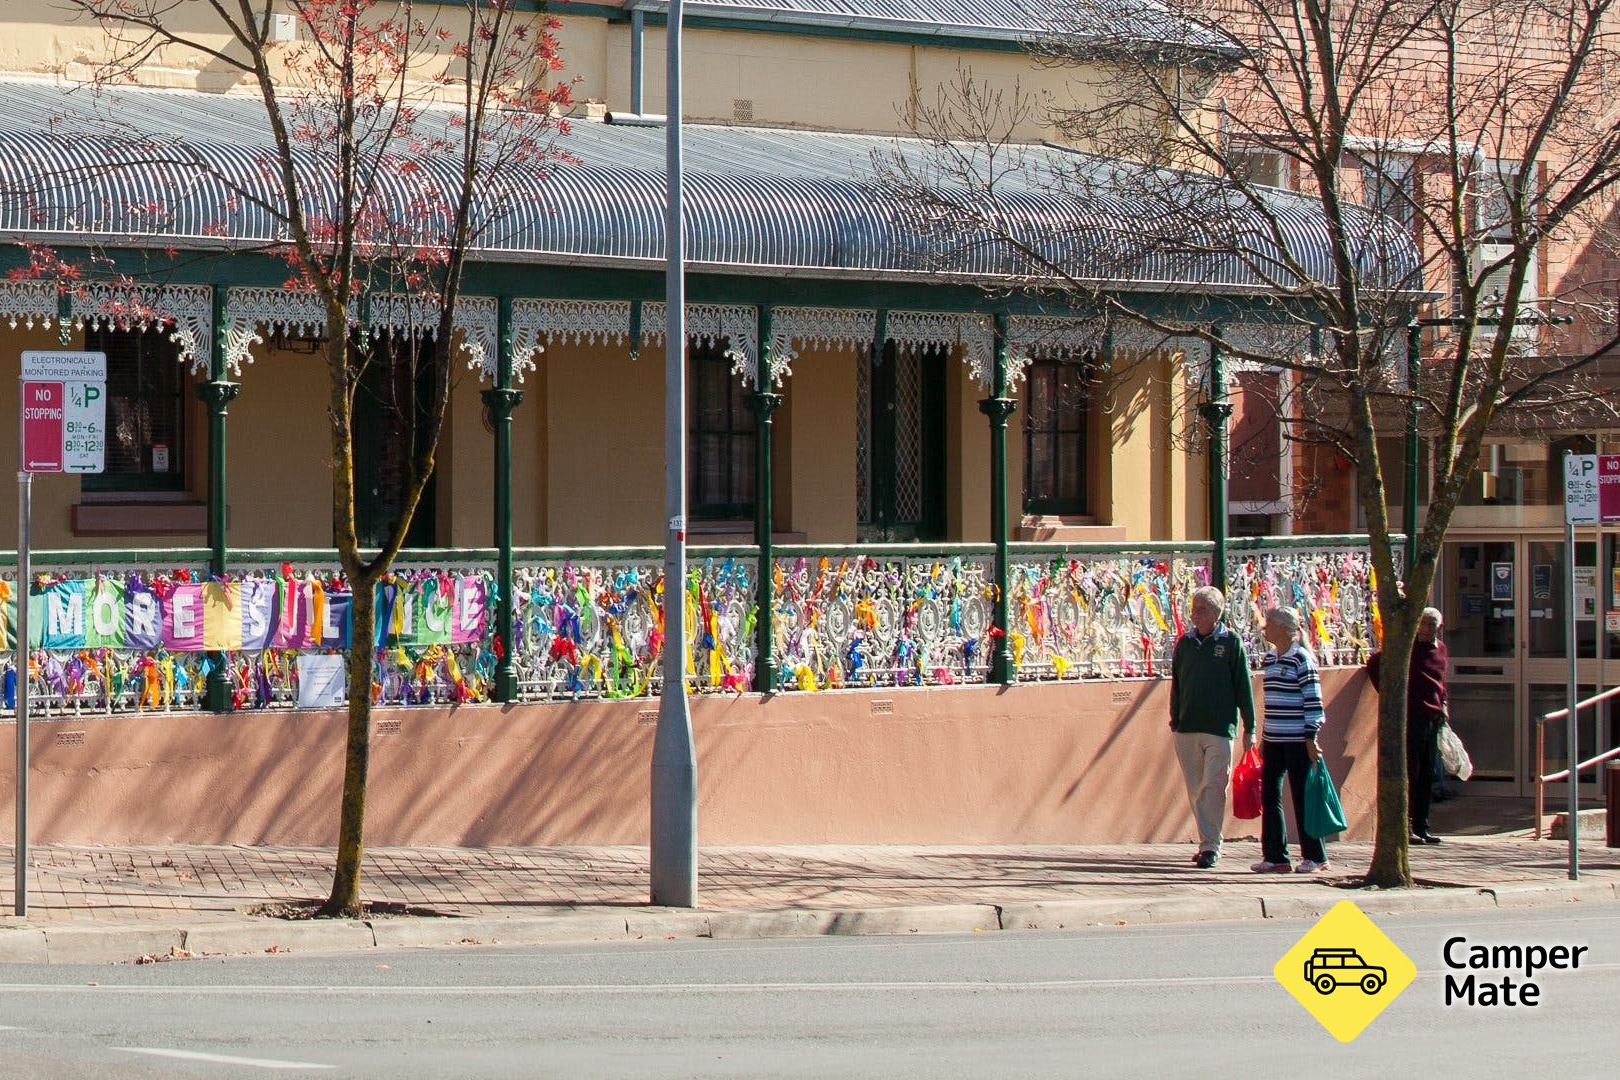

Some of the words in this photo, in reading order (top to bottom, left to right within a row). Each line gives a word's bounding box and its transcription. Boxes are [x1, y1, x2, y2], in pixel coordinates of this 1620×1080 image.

[71, 369, 104, 377] PARKING
[35, 389, 51, 401] NO
[25, 407, 62, 420] STOPPING
[1606, 461, 1619, 470] NO
[48, 591, 195, 638] MORE
[249, 588, 484, 638] SILNCE
